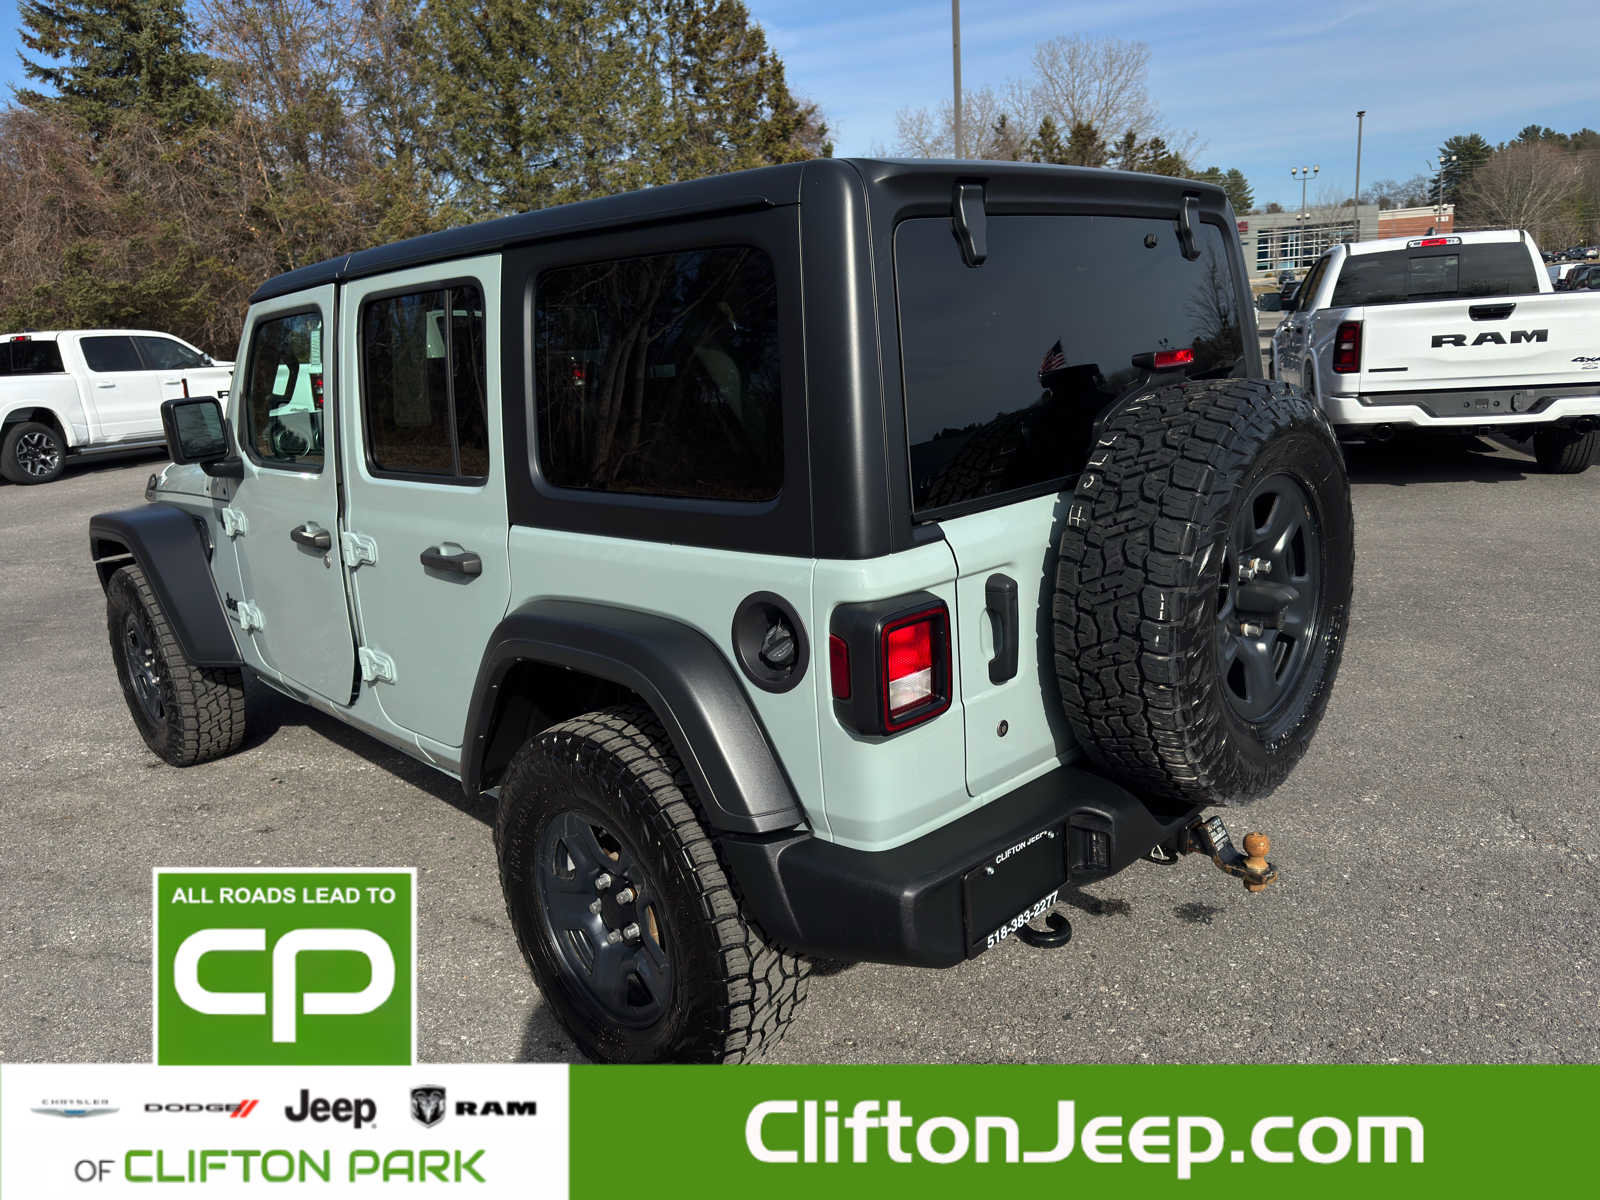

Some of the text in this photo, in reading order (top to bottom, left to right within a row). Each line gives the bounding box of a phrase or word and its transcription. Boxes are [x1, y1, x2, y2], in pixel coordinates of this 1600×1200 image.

[1431, 329, 1549, 348] RAM
[995, 841, 1026, 864] CLIFTON
[987, 890, 1059, 949] 518-383-2277
